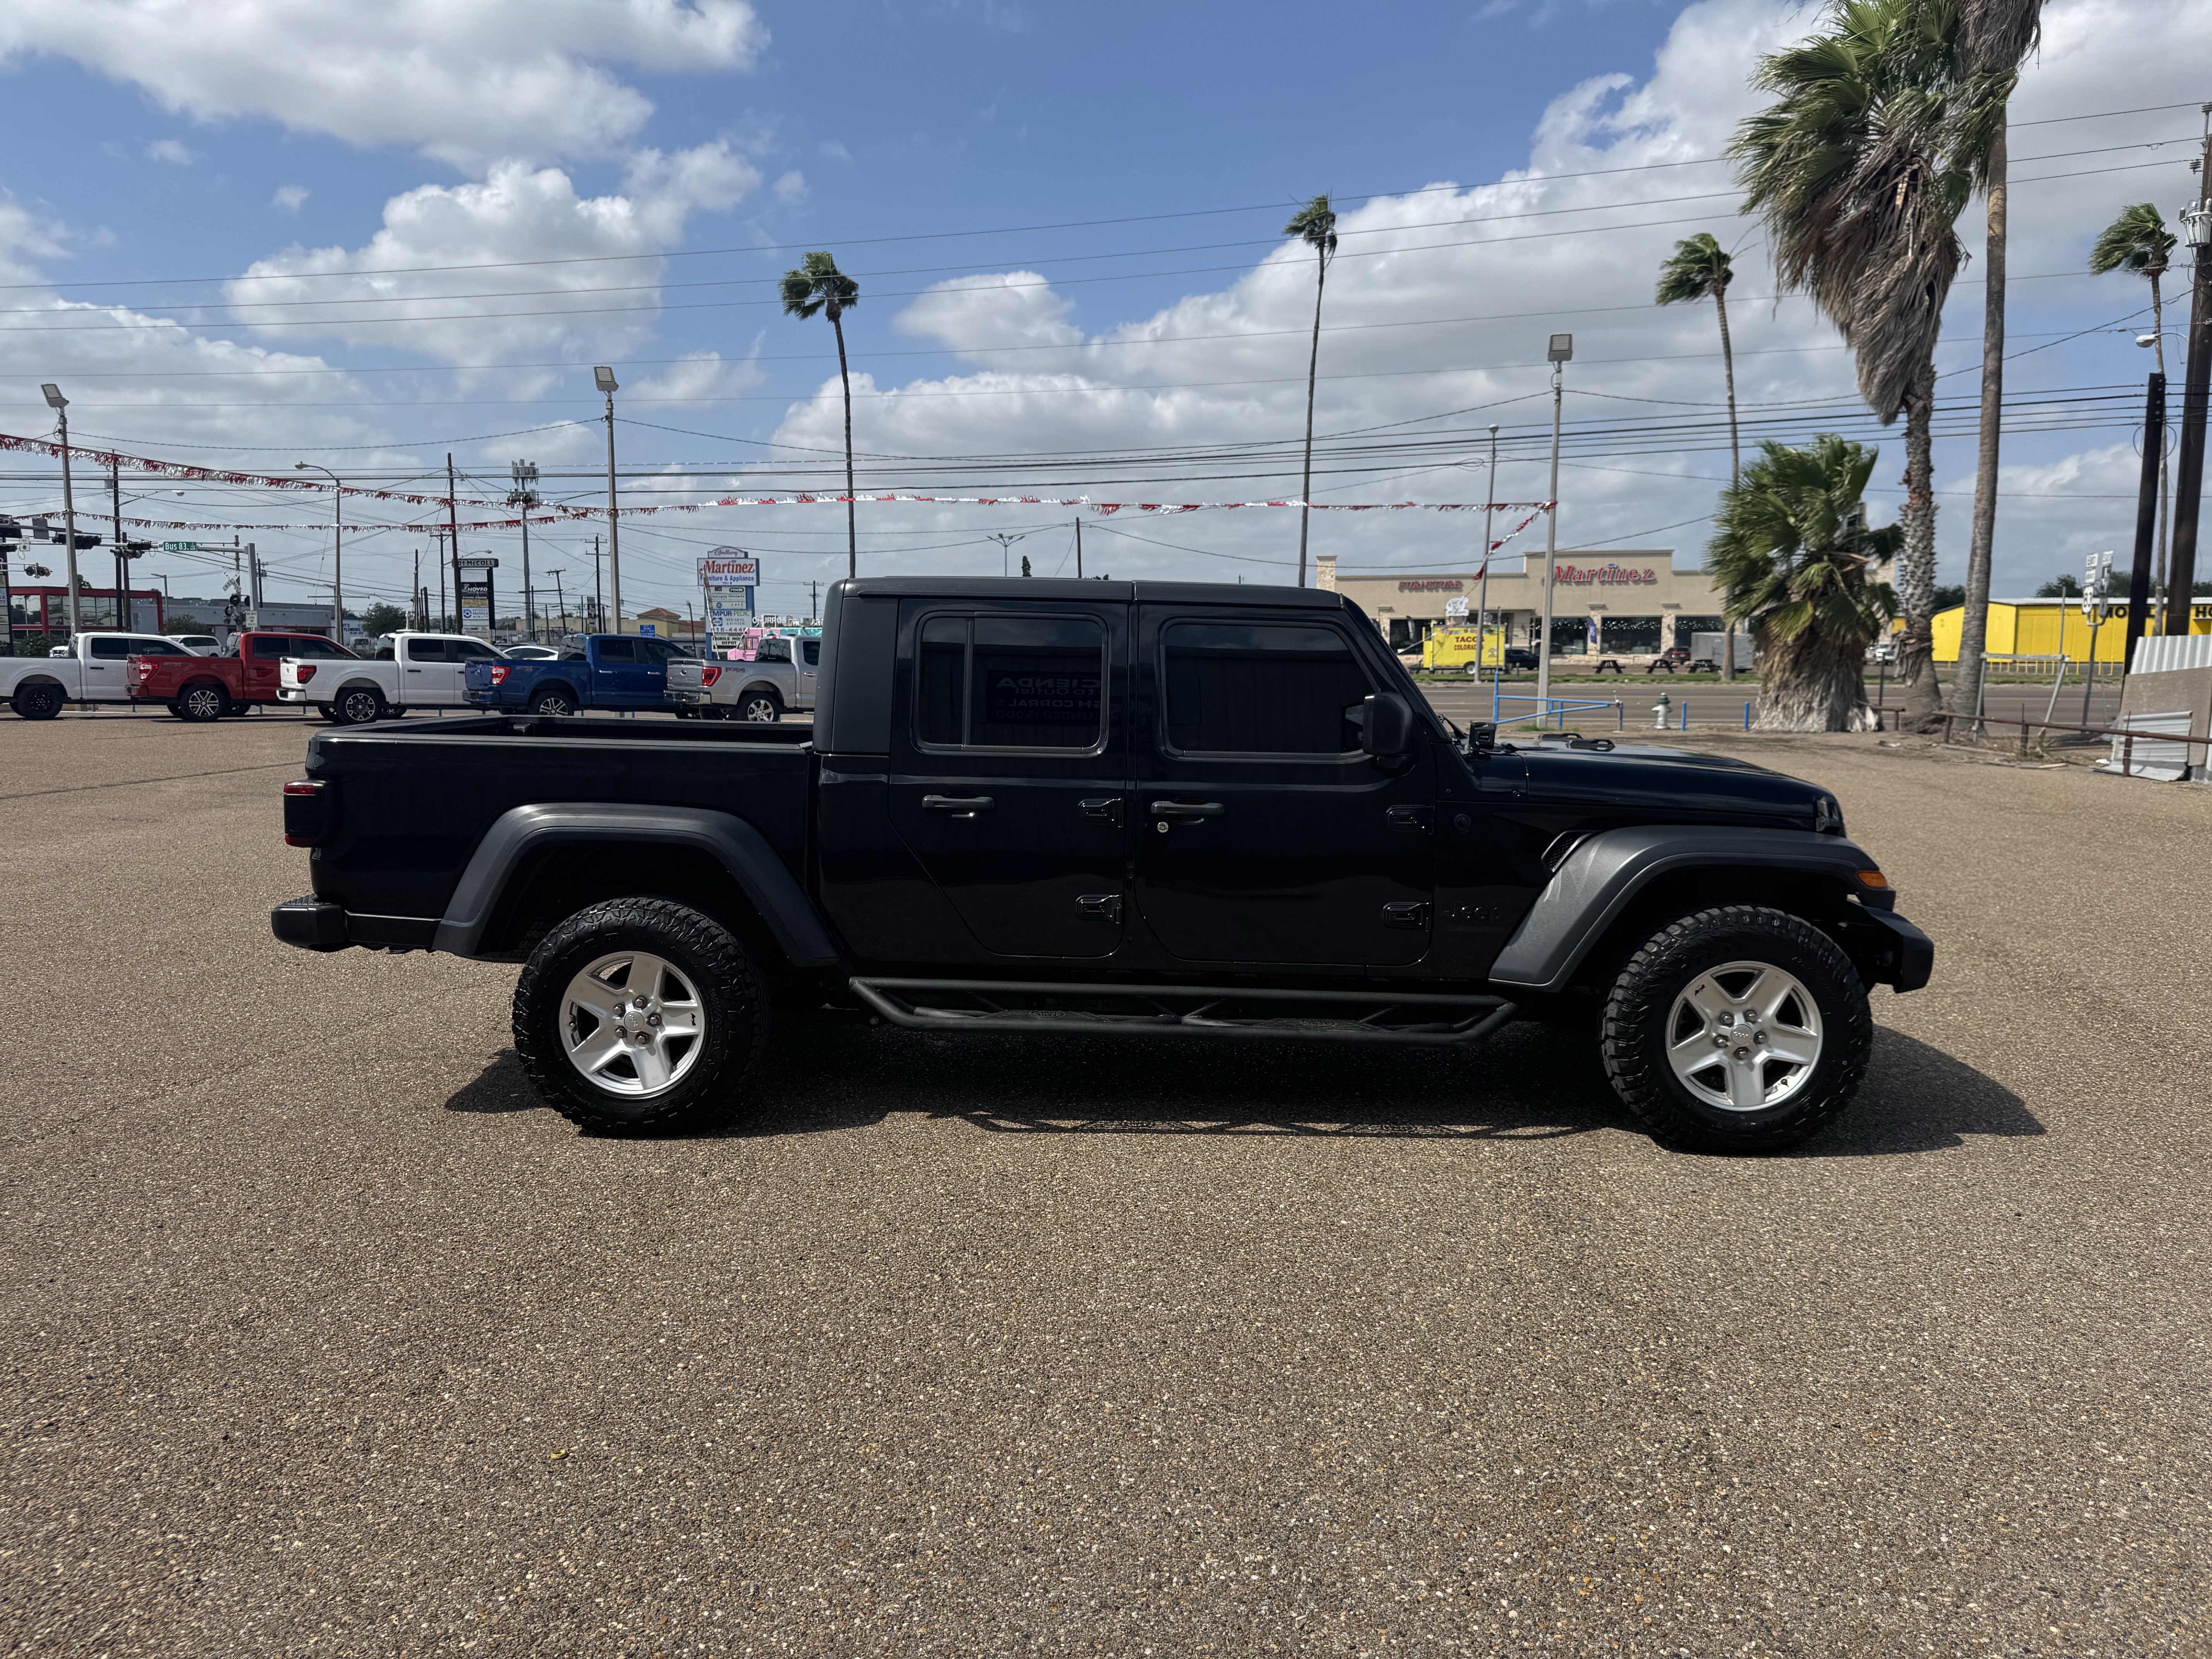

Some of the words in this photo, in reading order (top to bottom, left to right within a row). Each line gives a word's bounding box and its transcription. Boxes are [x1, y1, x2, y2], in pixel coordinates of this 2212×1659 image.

[699, 560, 754, 574] Martinez
[1551, 563, 1656, 582] Martinez
[1398, 581, 1461, 589] FURNITURE
